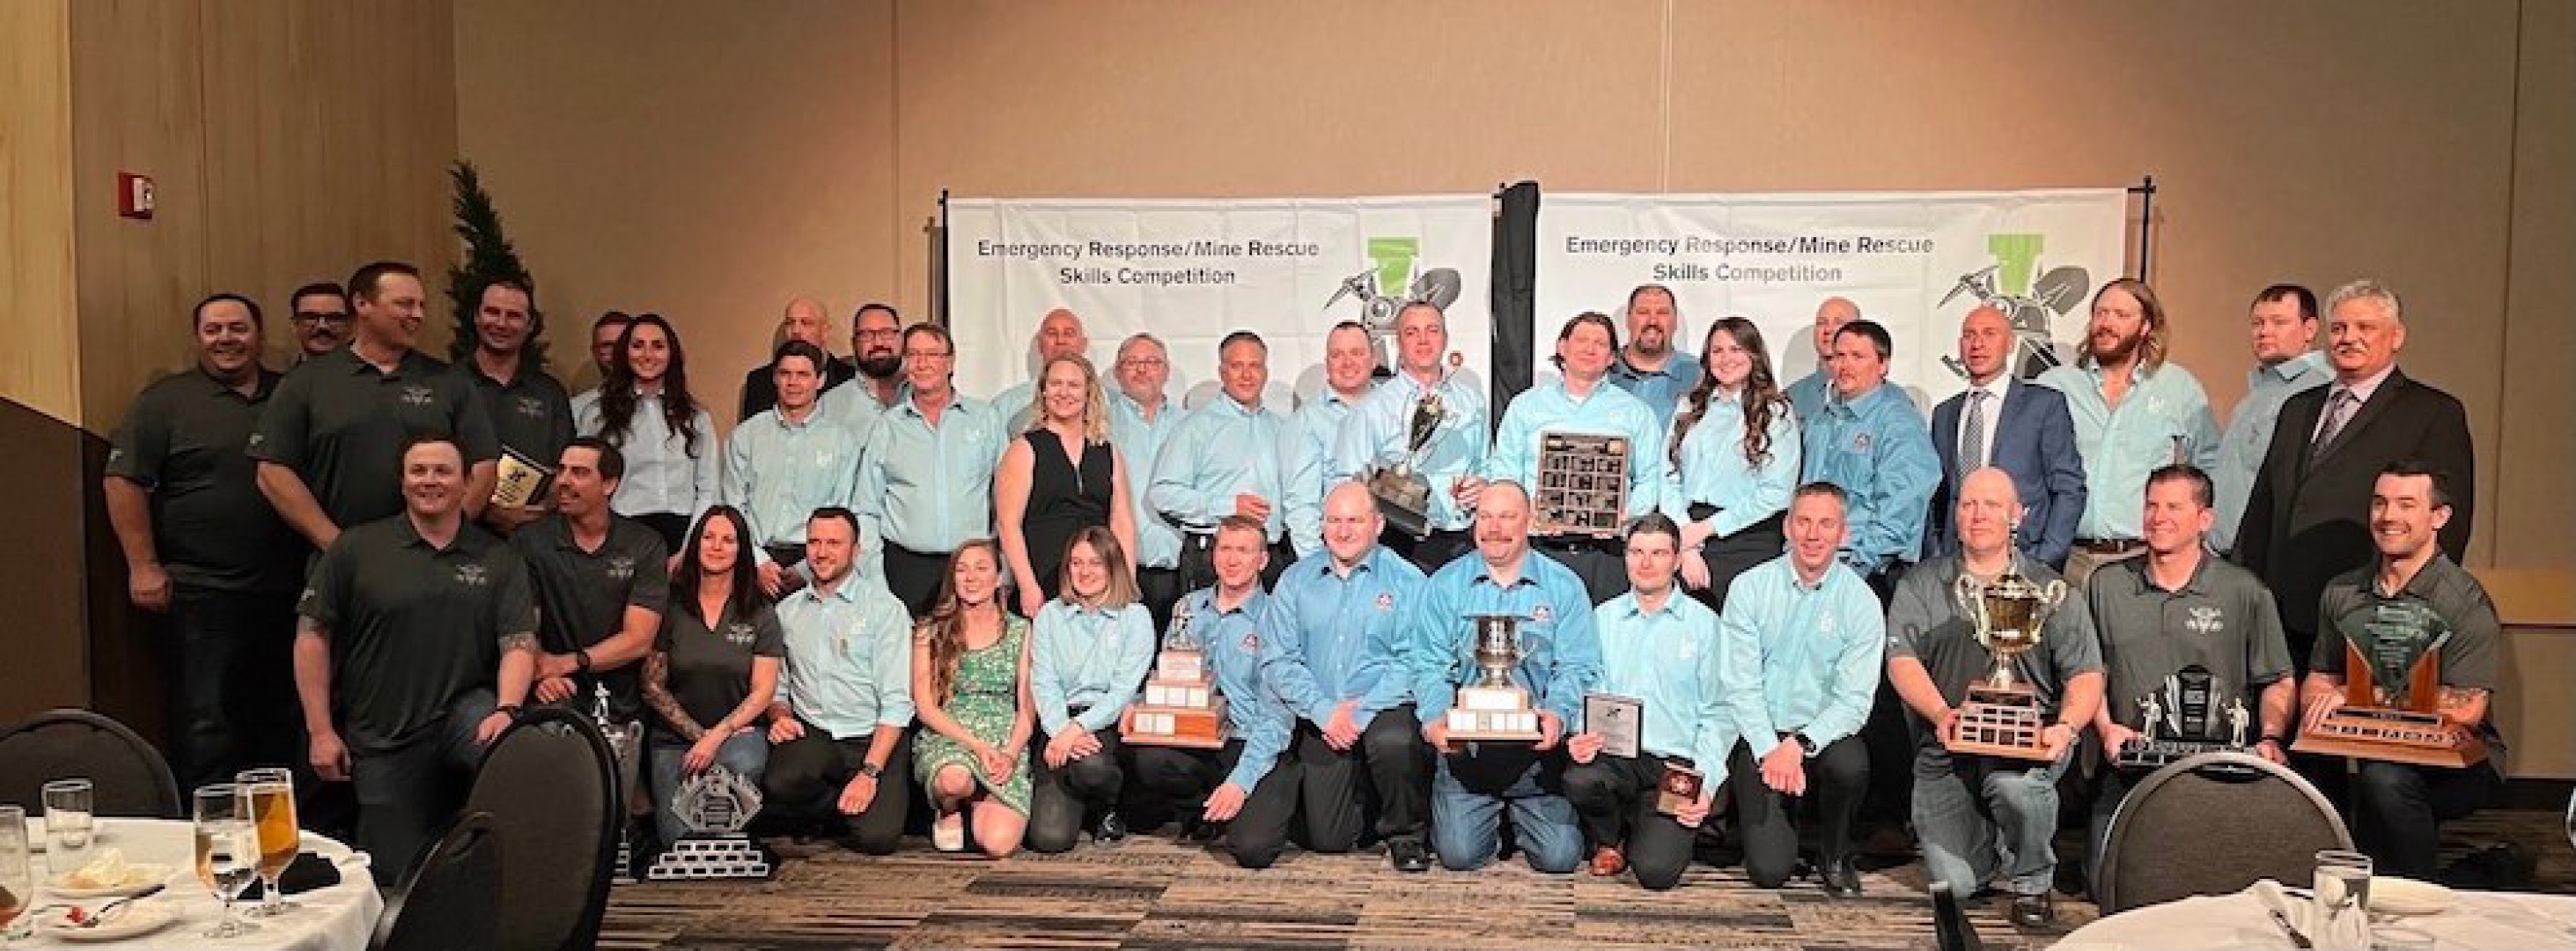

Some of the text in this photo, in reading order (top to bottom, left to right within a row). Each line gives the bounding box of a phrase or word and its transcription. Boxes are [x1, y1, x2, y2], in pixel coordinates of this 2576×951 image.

[978, 240, 1320, 261] Emergency Response/Mine Rescue
[1565, 236, 1933, 257] Emergency Response/Mine Rescue
[1060, 267, 1235, 286] Skills Competition
[1653, 262, 1843, 284] Skills Competition
